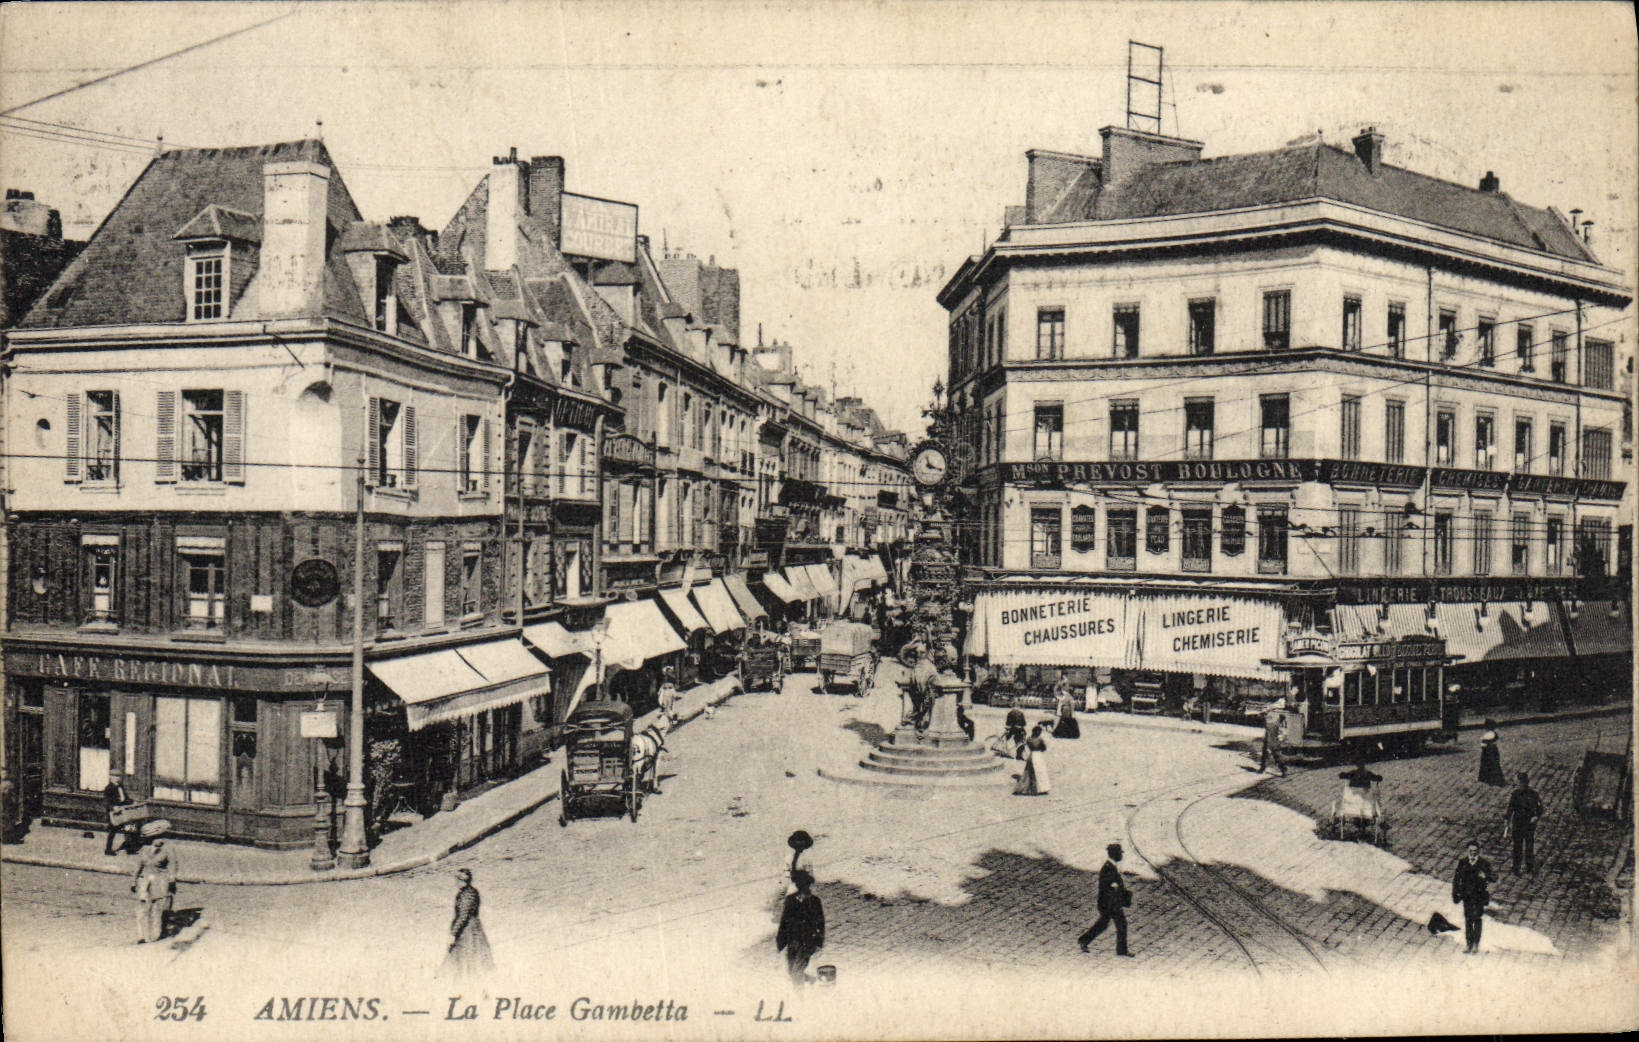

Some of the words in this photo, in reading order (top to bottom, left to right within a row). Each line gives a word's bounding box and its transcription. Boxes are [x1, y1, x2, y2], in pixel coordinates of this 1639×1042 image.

[1056, 464, 1162, 480] PREVOST
[1177, 462, 1302, 479] BOULOGNE
[1357, 587, 1417, 602] LINGERIE
[1001, 598, 1091, 625] BONNETERIE
[1162, 606, 1231, 628] LINGERIE
[1024, 618, 1116, 646] CHAUSSURES
[1173, 627, 1260, 652] CHEMISERIE
